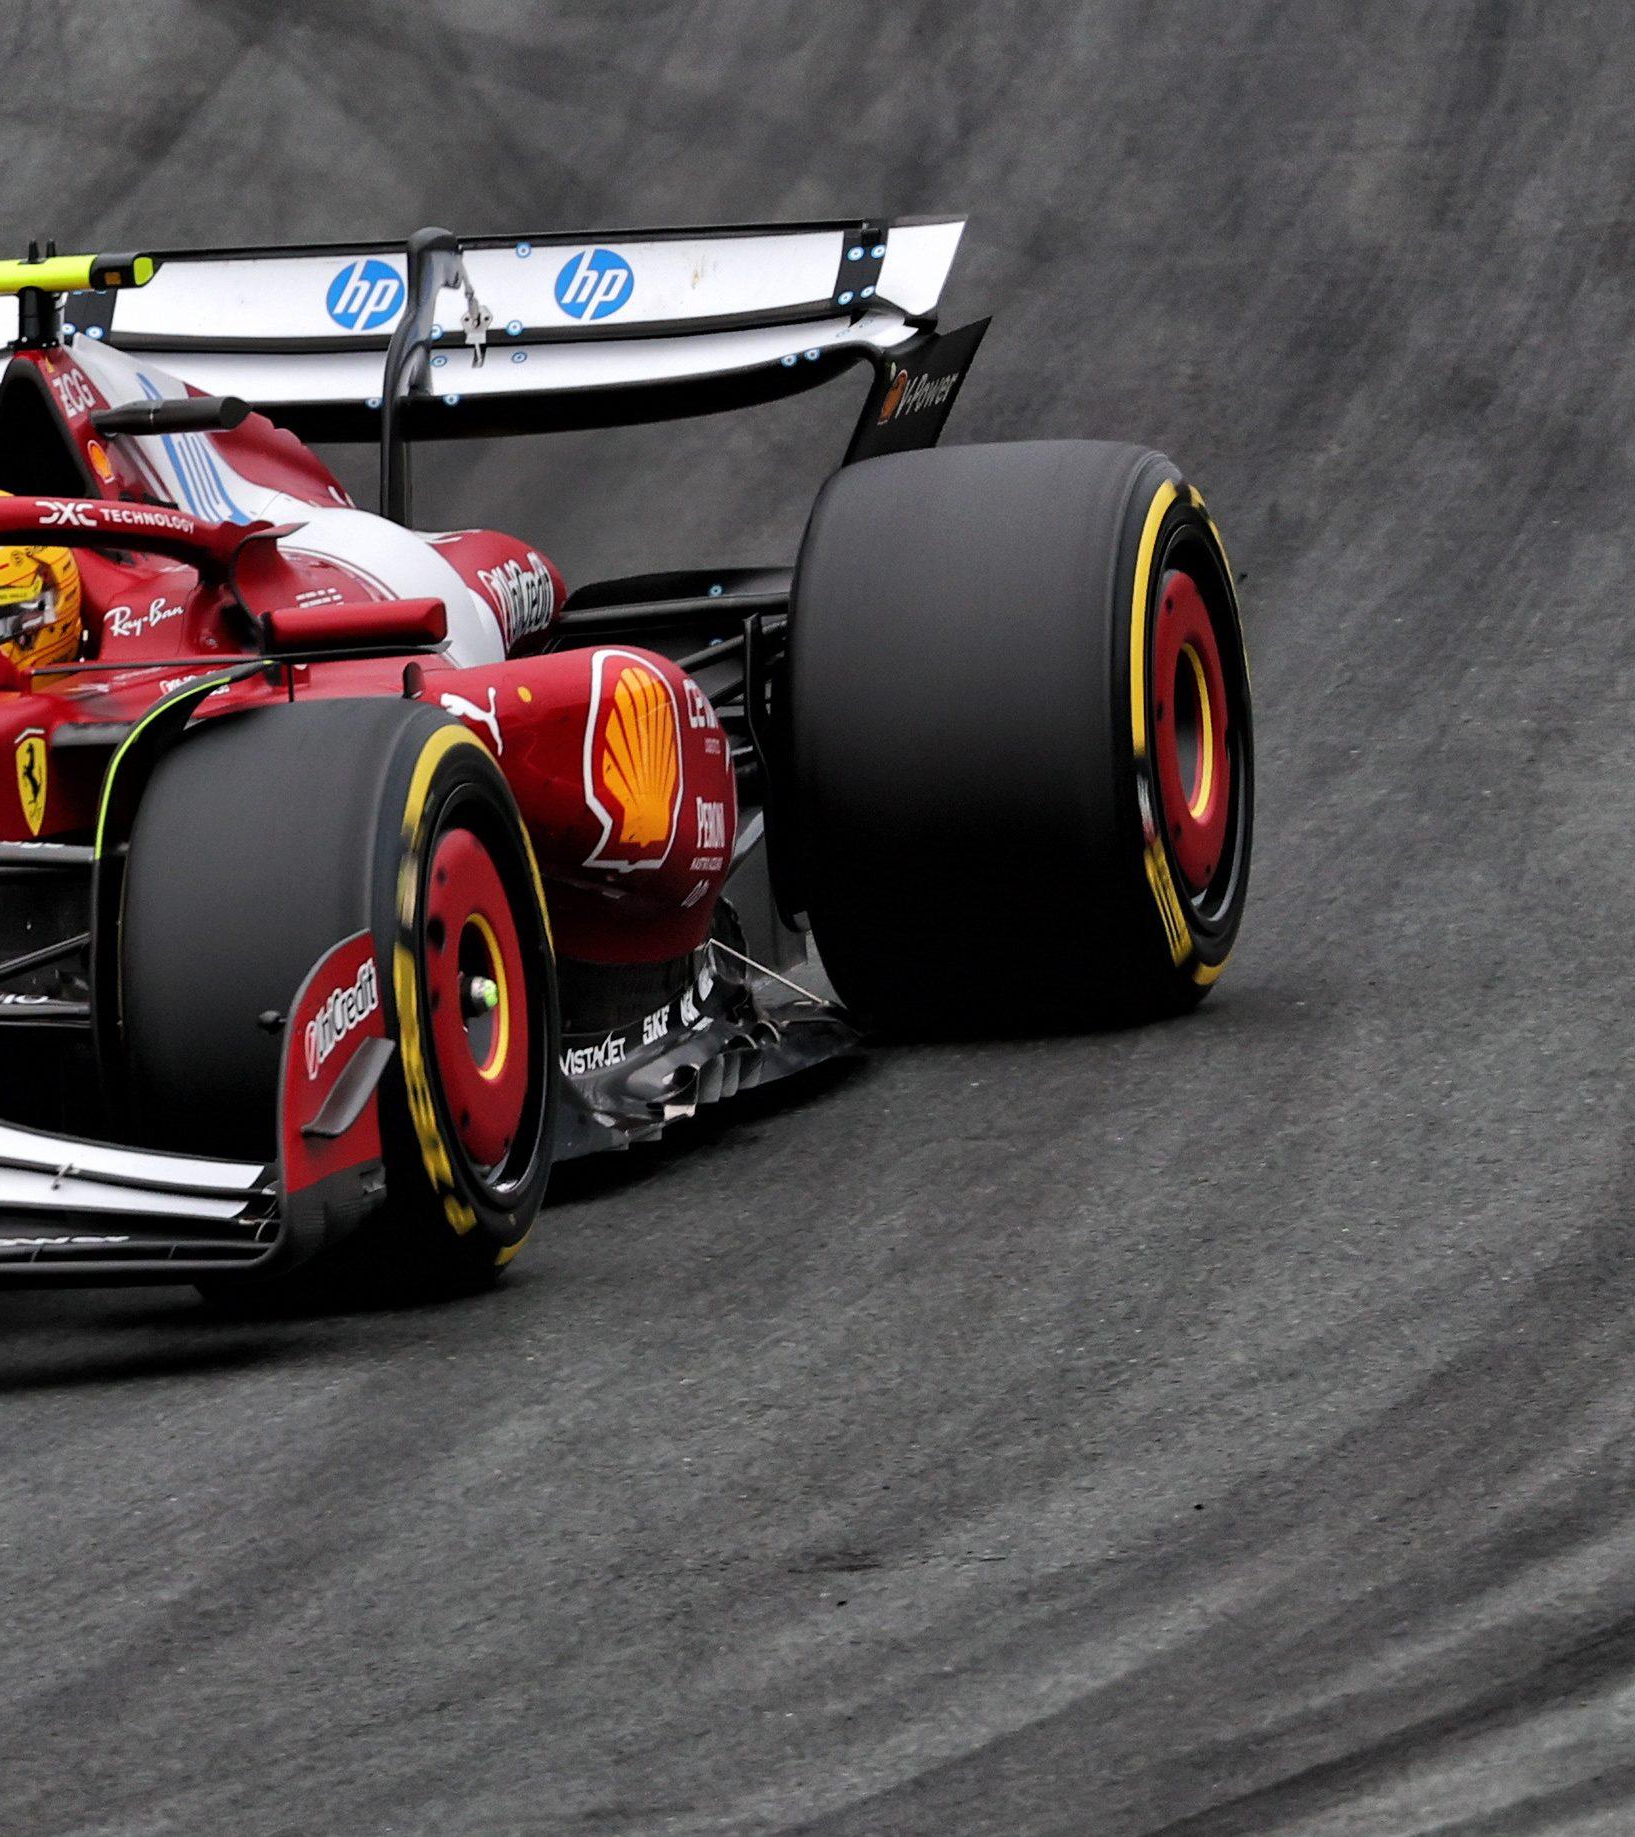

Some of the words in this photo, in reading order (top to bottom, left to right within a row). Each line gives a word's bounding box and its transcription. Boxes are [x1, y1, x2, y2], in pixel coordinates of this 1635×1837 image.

[329, 260, 403, 330] hp
[560, 249, 632, 319] hp
[894, 372, 960, 419] V-Power
[35, 501, 97, 527] DXC
[100, 507, 195, 534] TECHNOLOGY
[104, 598, 184, 637] Ray-Ban
[643, 1005, 670, 1045] SKF
